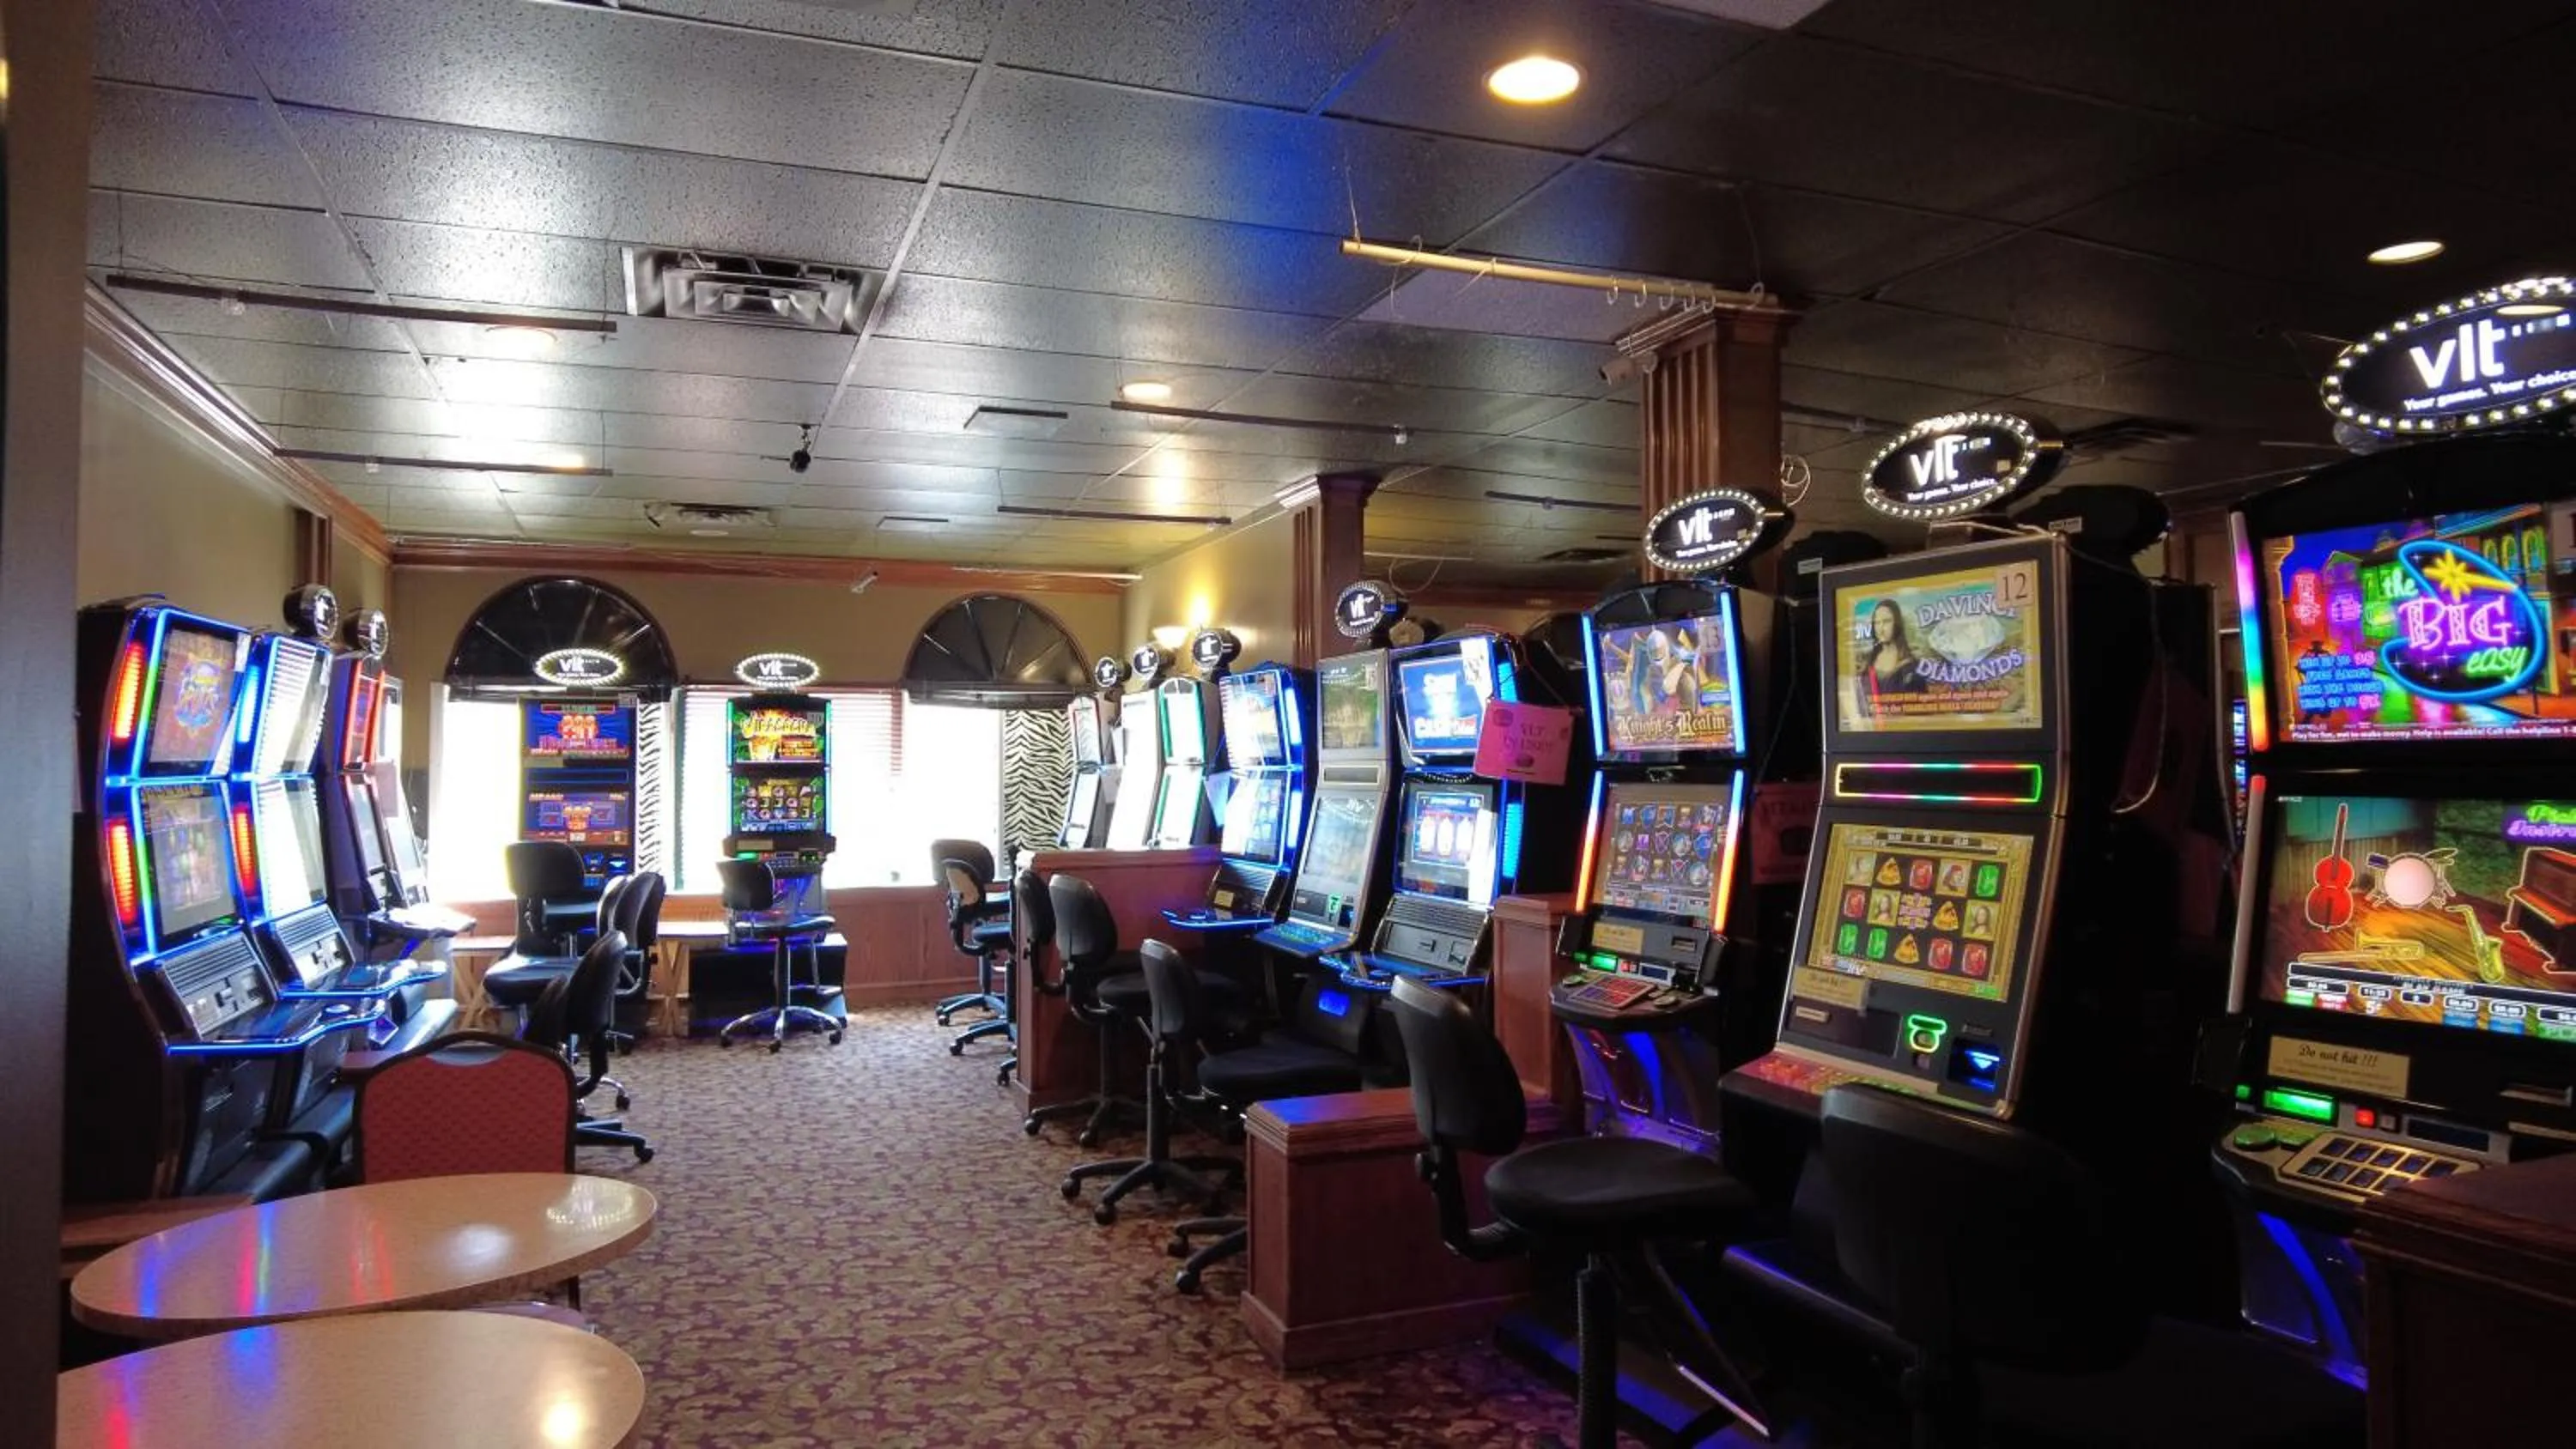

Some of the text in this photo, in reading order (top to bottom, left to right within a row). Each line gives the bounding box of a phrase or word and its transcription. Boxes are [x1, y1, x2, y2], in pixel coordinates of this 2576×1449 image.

[2409, 318, 2505, 389] vlt
[2002, 572, 2028, 602] 12
[2397, 595, 2512, 651] BIG
[1916, 649, 2023, 682] DIAMONDS
[2465, 646, 2530, 684] easy
[1675, 709, 1726, 736] Realm
[2298, 1043, 2317, 1058] Do
[2341, 1051, 2360, 1065] hit
